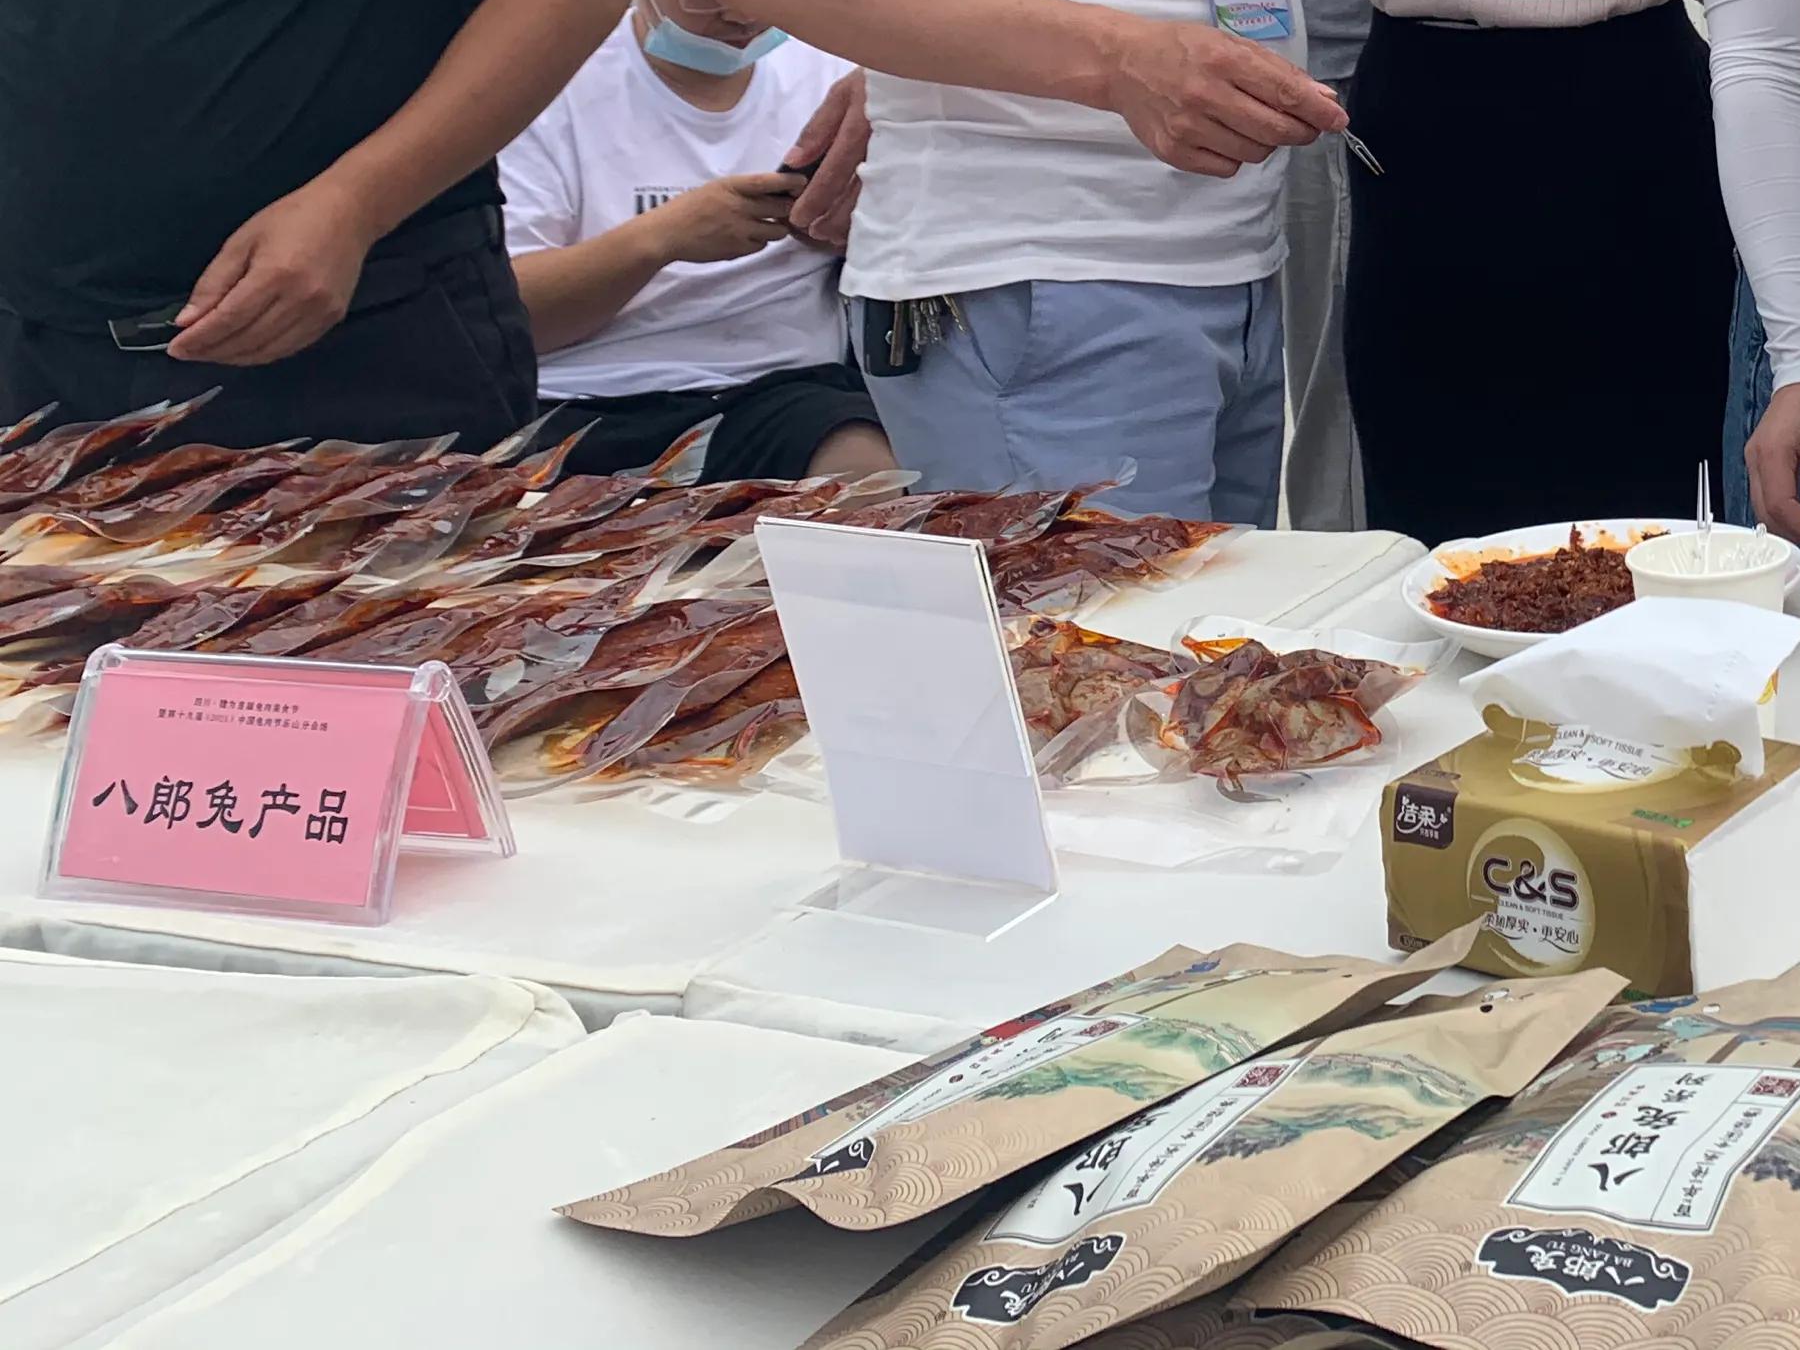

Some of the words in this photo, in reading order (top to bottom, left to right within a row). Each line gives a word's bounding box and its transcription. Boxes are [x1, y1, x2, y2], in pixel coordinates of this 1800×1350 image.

[1589, 734, 1612, 748] SOFT
[1615, 741, 1644, 757] TISSUE
[92, 775, 349, 844] 八郎兔产品
[1396, 800, 1438, 828] 洁柔
[1482, 856, 1580, 912] C&S
[1525, 1243, 1645, 1288] 八郎兔
